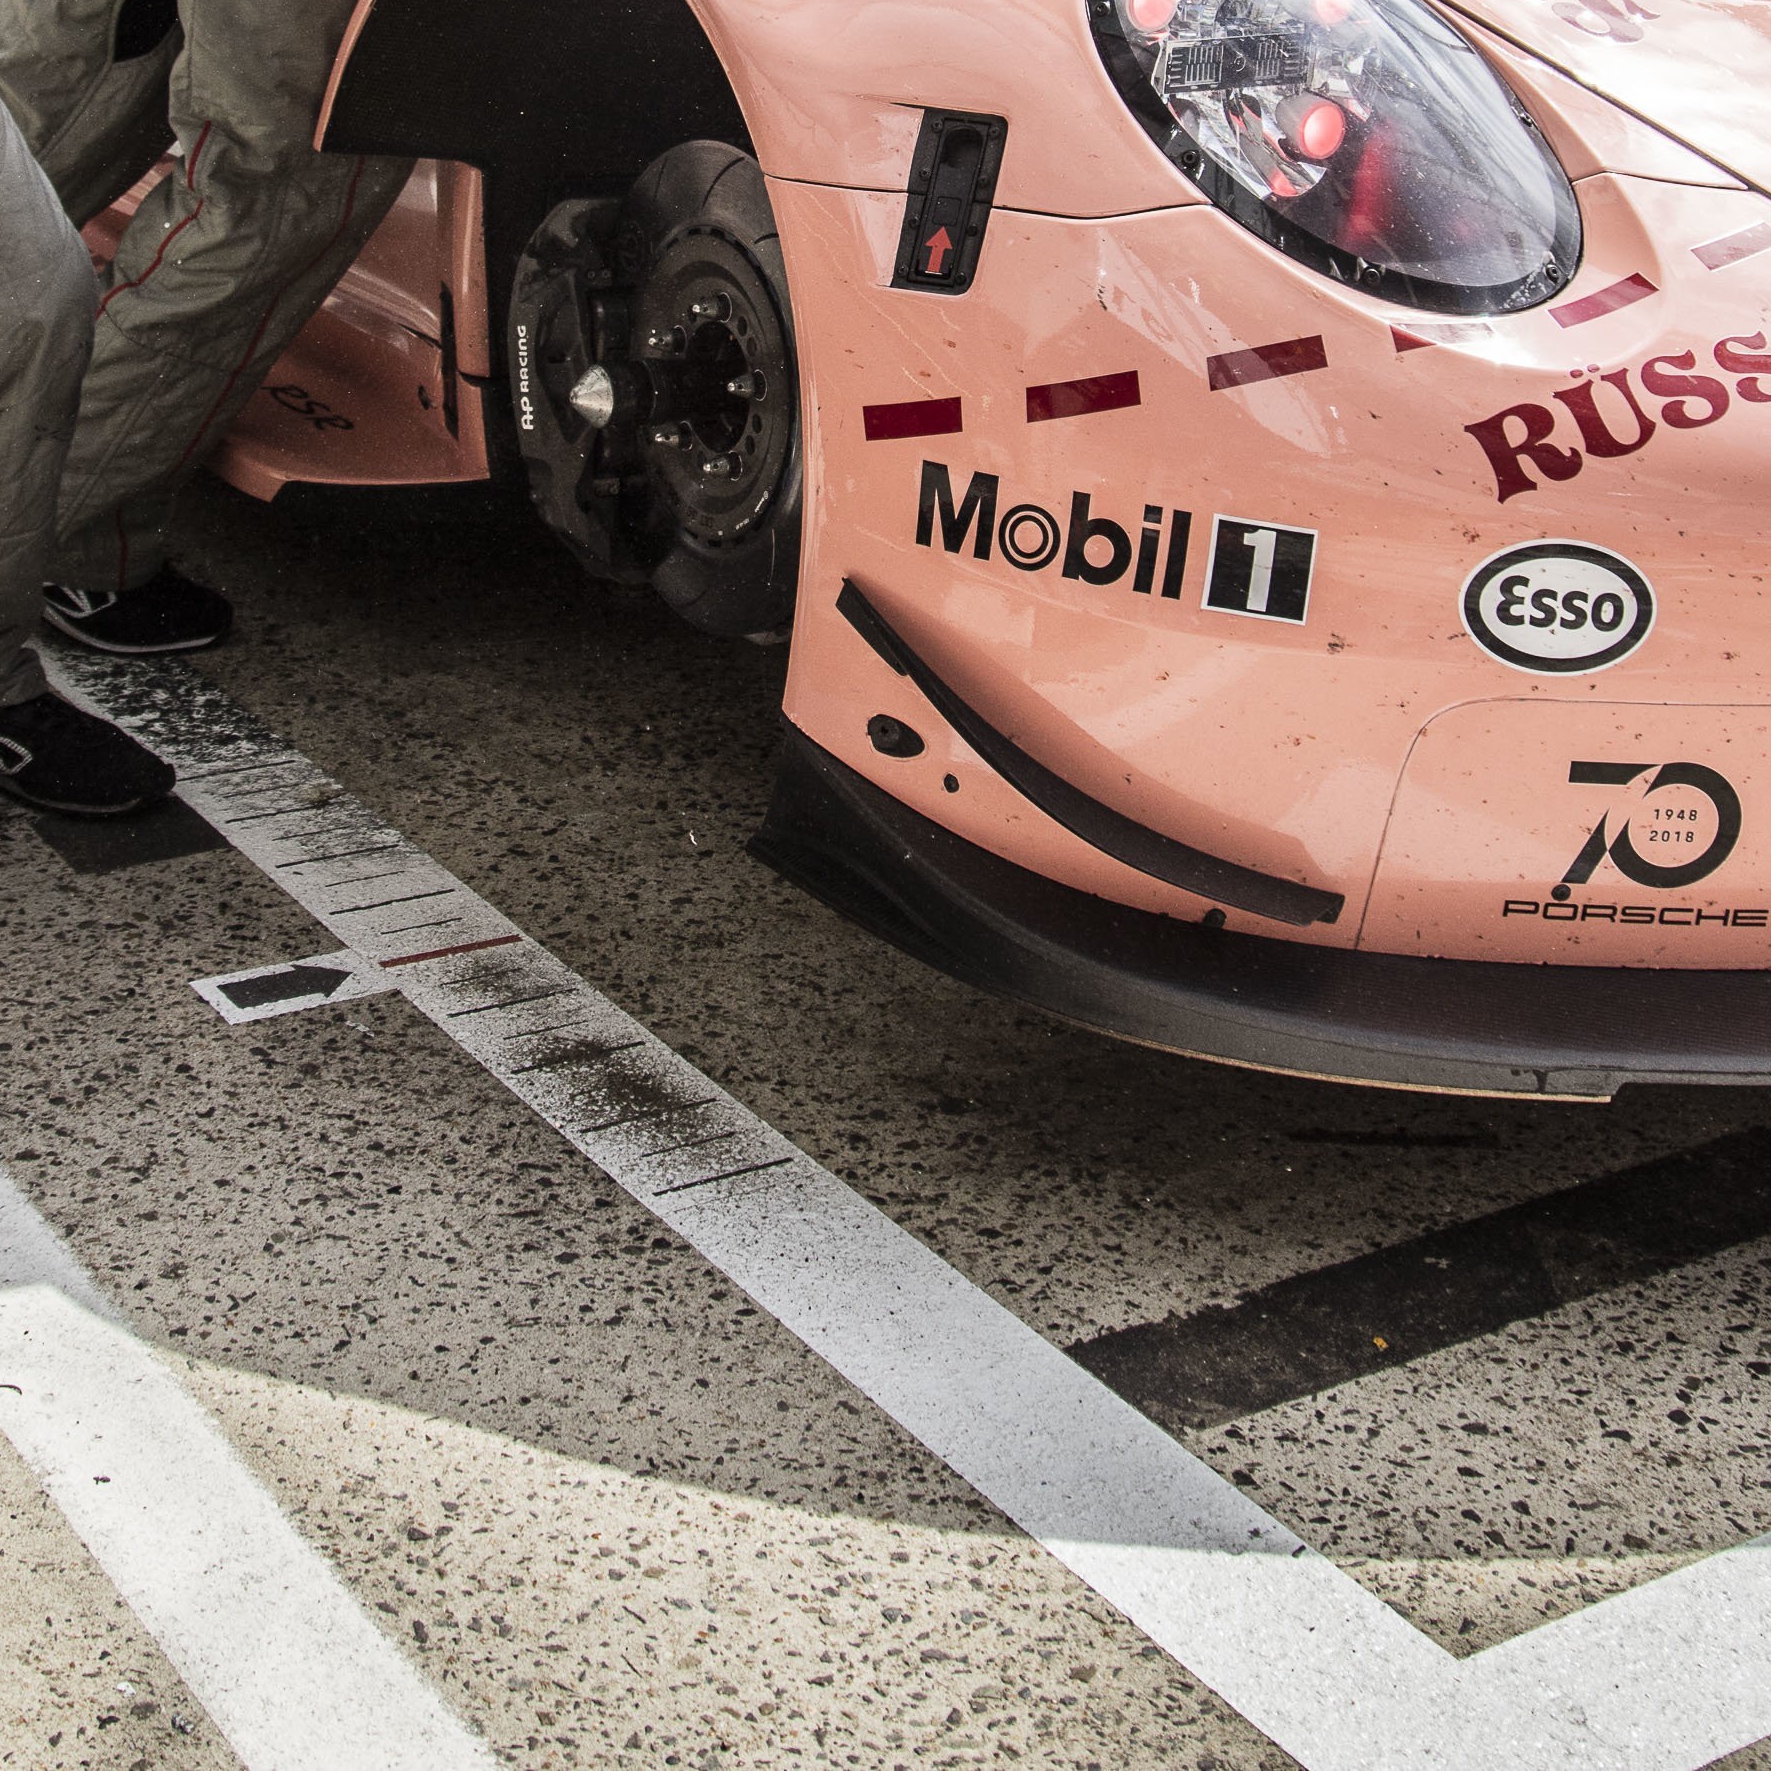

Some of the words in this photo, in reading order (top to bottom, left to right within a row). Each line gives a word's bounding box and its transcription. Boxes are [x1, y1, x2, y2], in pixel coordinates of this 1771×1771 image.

[516, 325, 530, 393] RACING
[520, 396, 534, 430] AP
[915, 460, 1193, 601] Mobil
[1560, 760, 1743, 888] 70
[1652, 807, 1699, 823] 1948
[1648, 829, 1696, 845] 2018
[1502, 898, 1771, 929] PORSCHE
